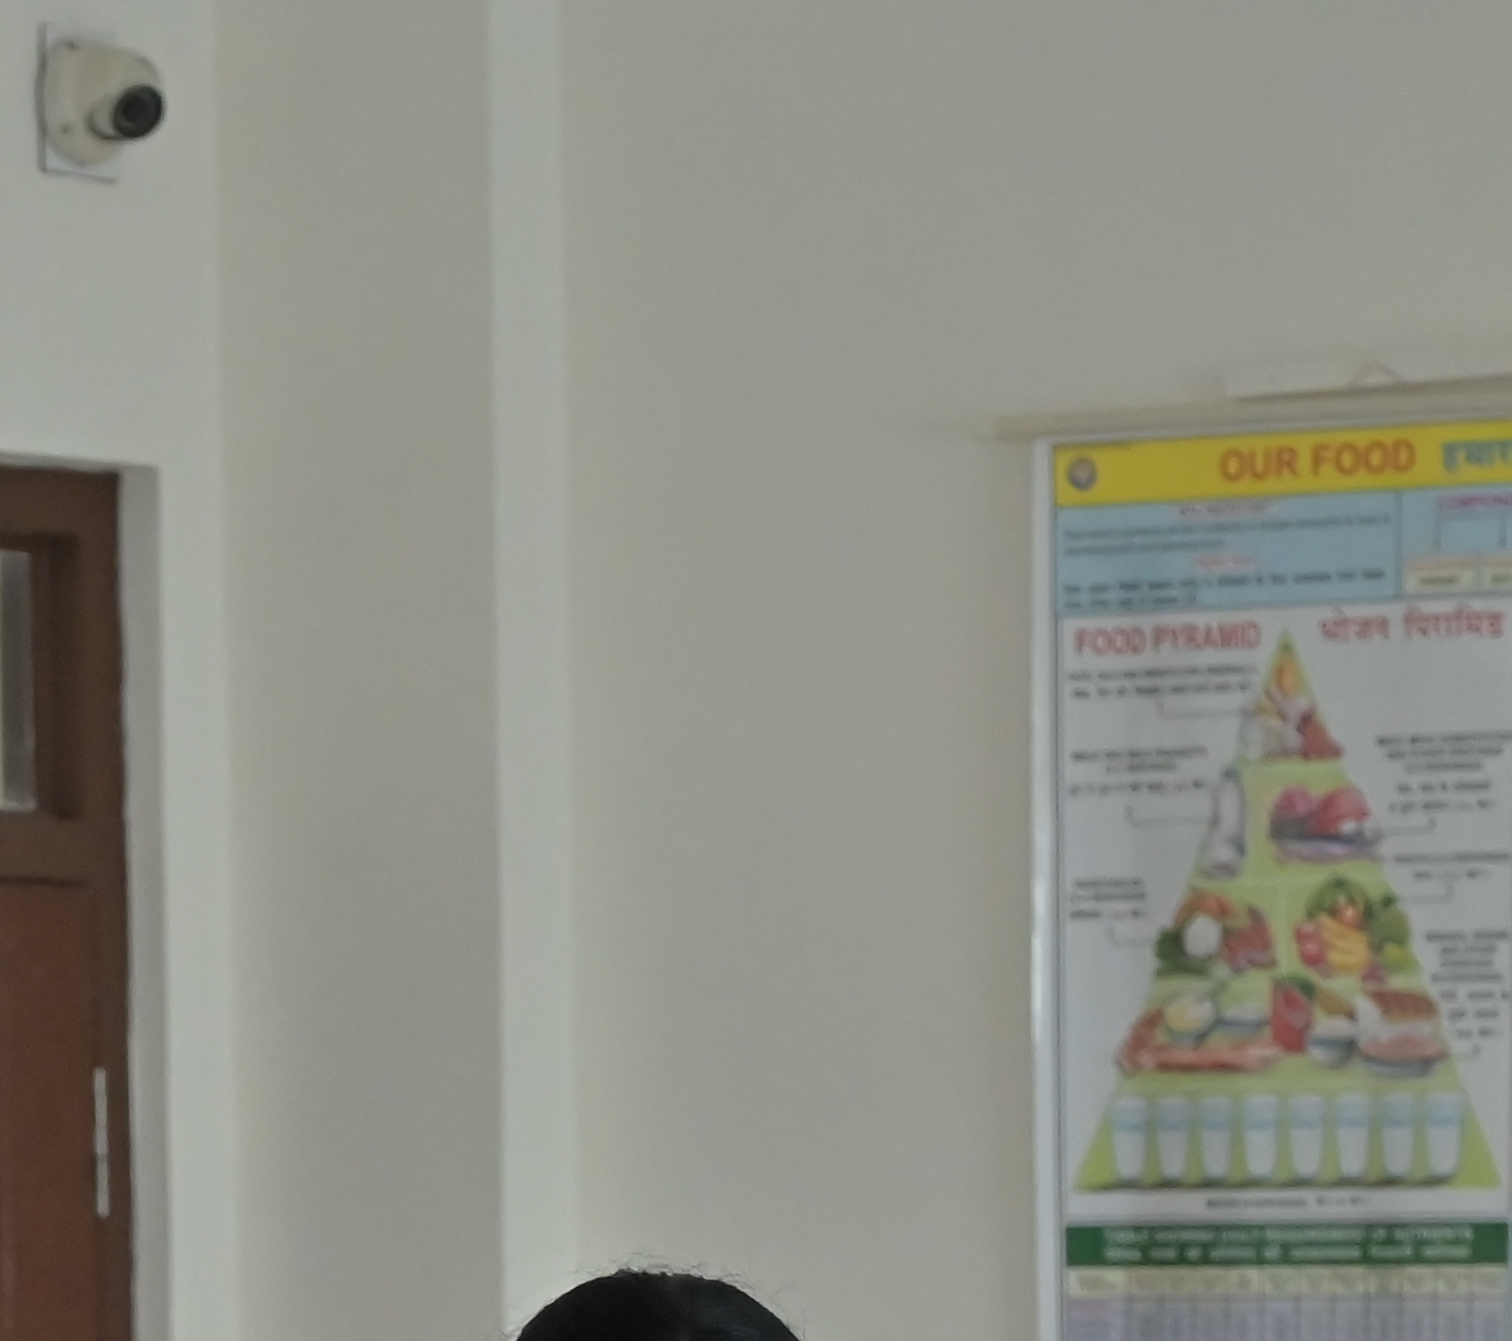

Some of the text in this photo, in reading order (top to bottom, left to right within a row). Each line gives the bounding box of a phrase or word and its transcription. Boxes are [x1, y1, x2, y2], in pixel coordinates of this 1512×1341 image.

[1219, 438, 1417, 482] OUR FOOD
[1074, 620, 1263, 656] FOOD PYRAMID
